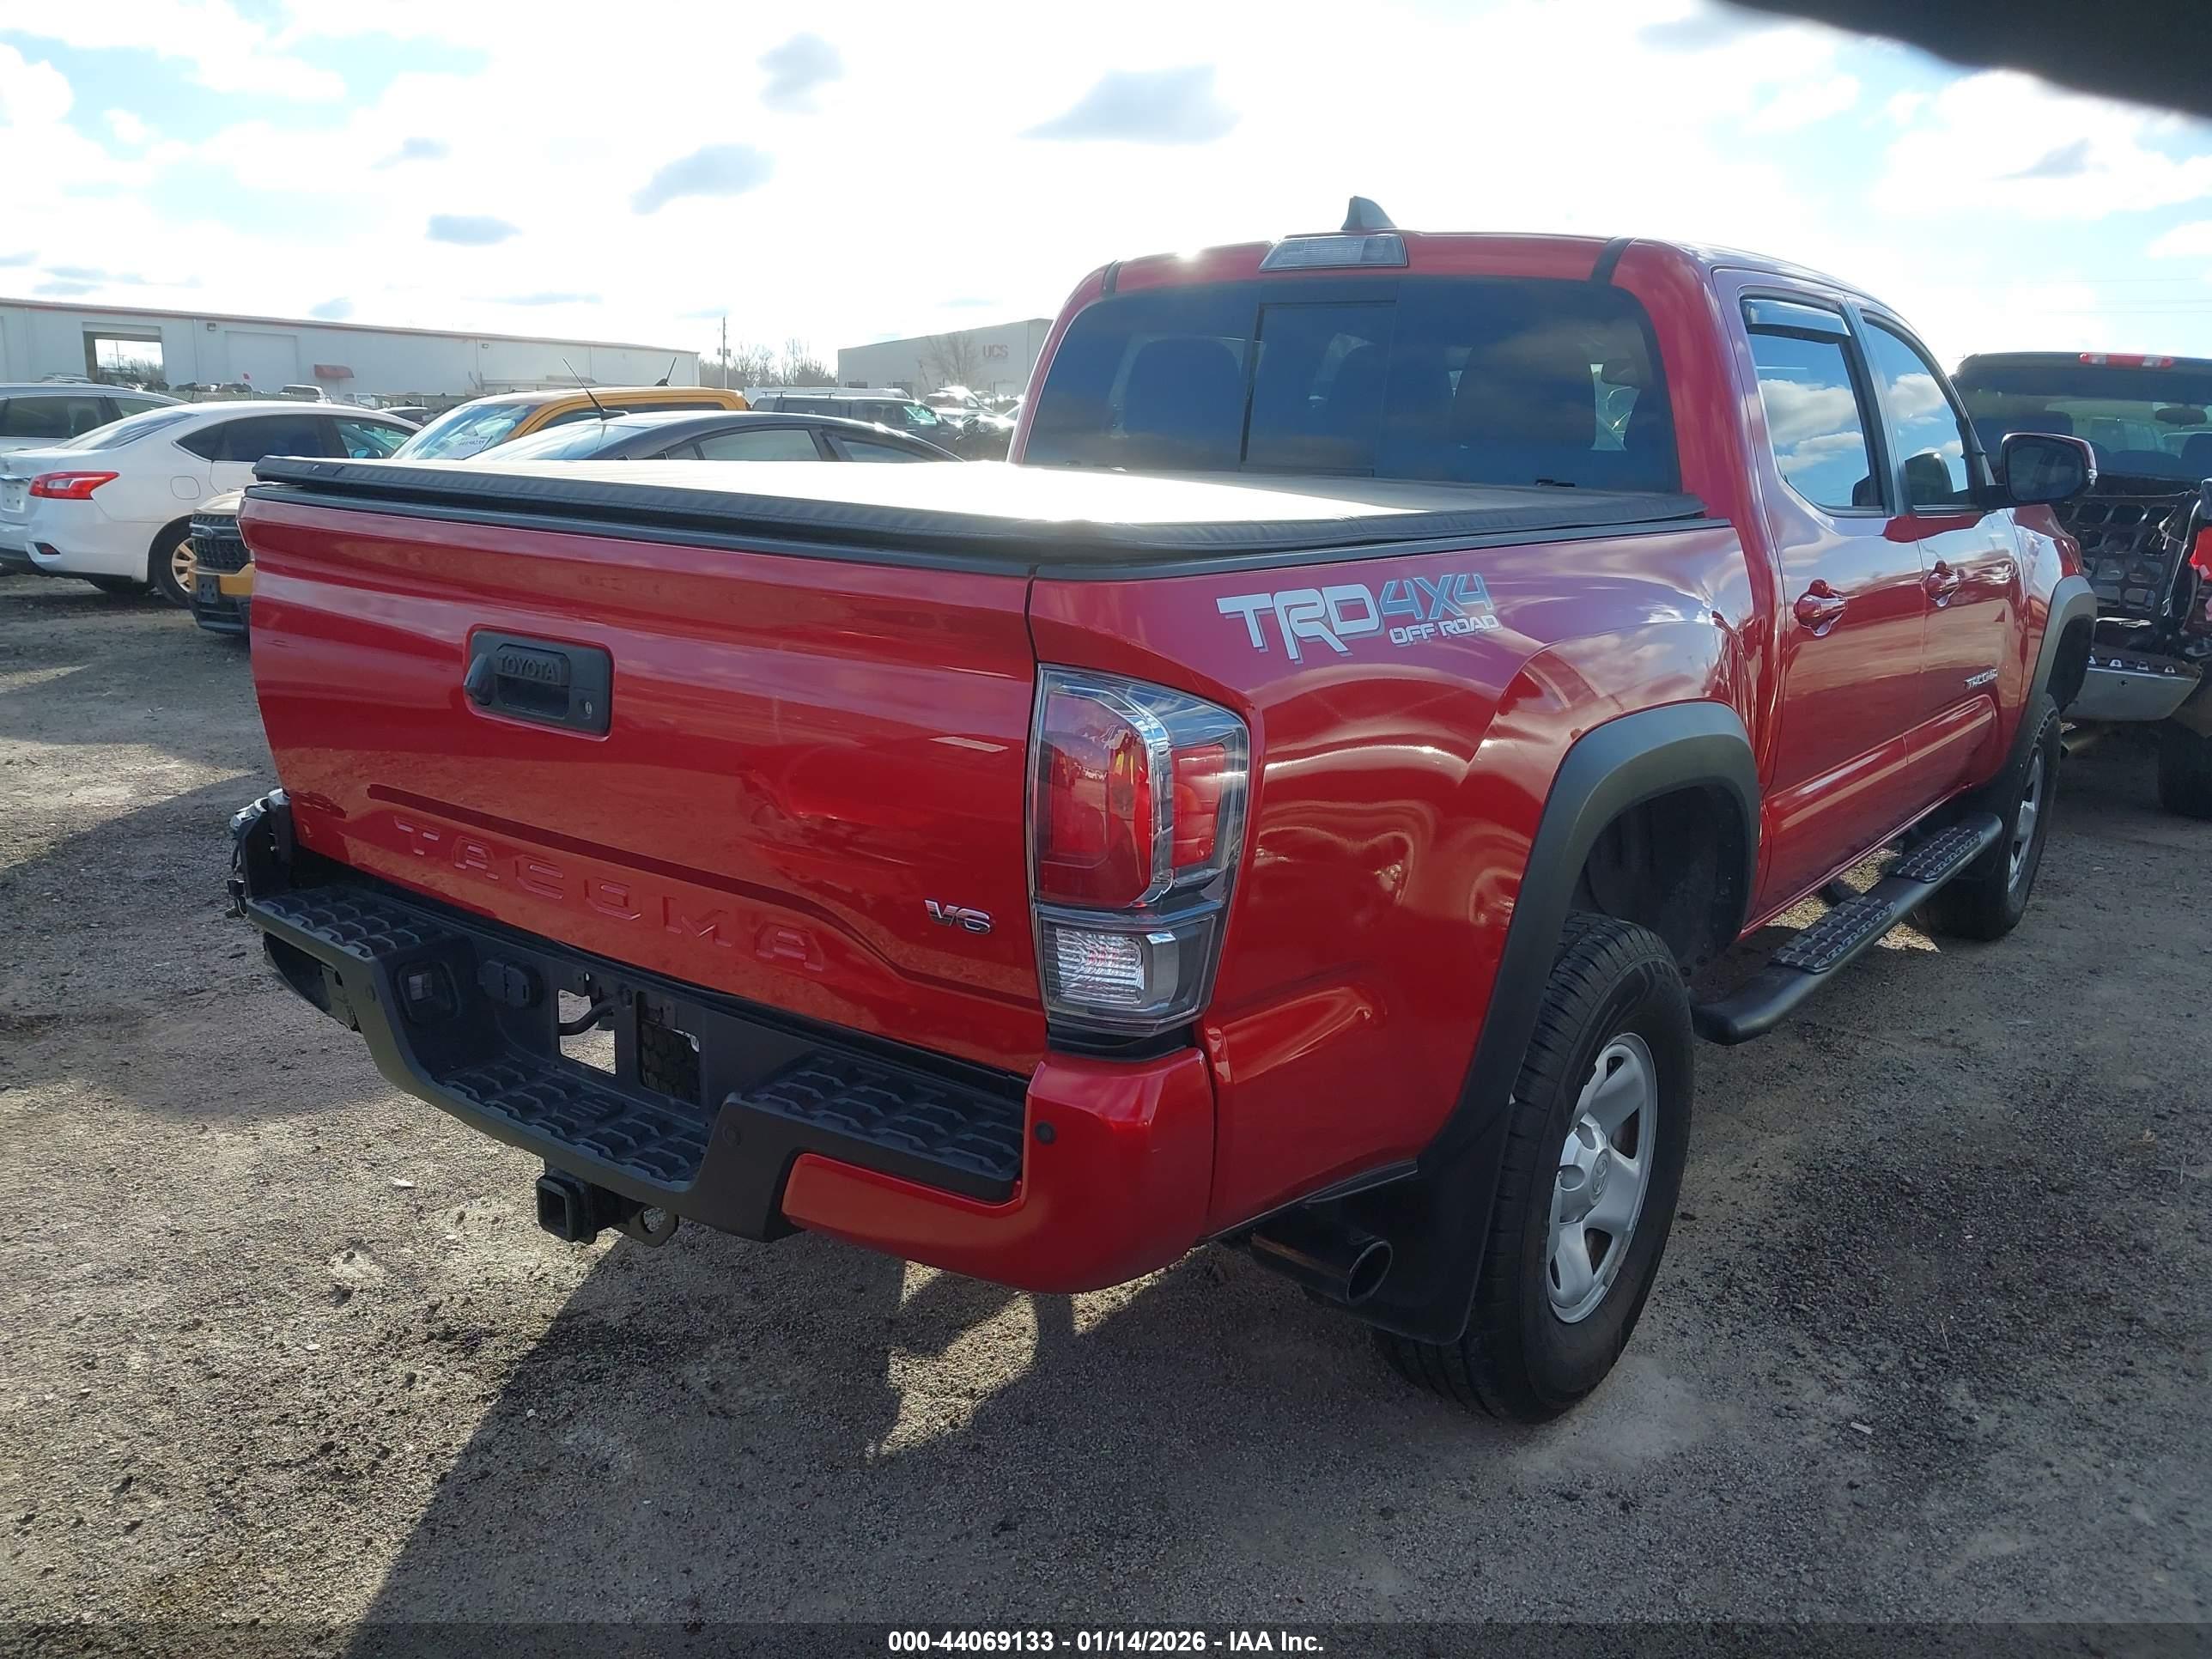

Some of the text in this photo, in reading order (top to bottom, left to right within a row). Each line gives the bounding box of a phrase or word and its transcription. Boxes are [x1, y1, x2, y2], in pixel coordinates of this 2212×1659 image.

[982, 343, 1009, 358] UCS
[1216, 583, 1383, 662] TRD
[1389, 614, 1501, 646] OFF ROAD
[498, 654, 562, 681] TOYOTA
[393, 816, 825, 971] TACOMA
[924, 898, 991, 934] V6
